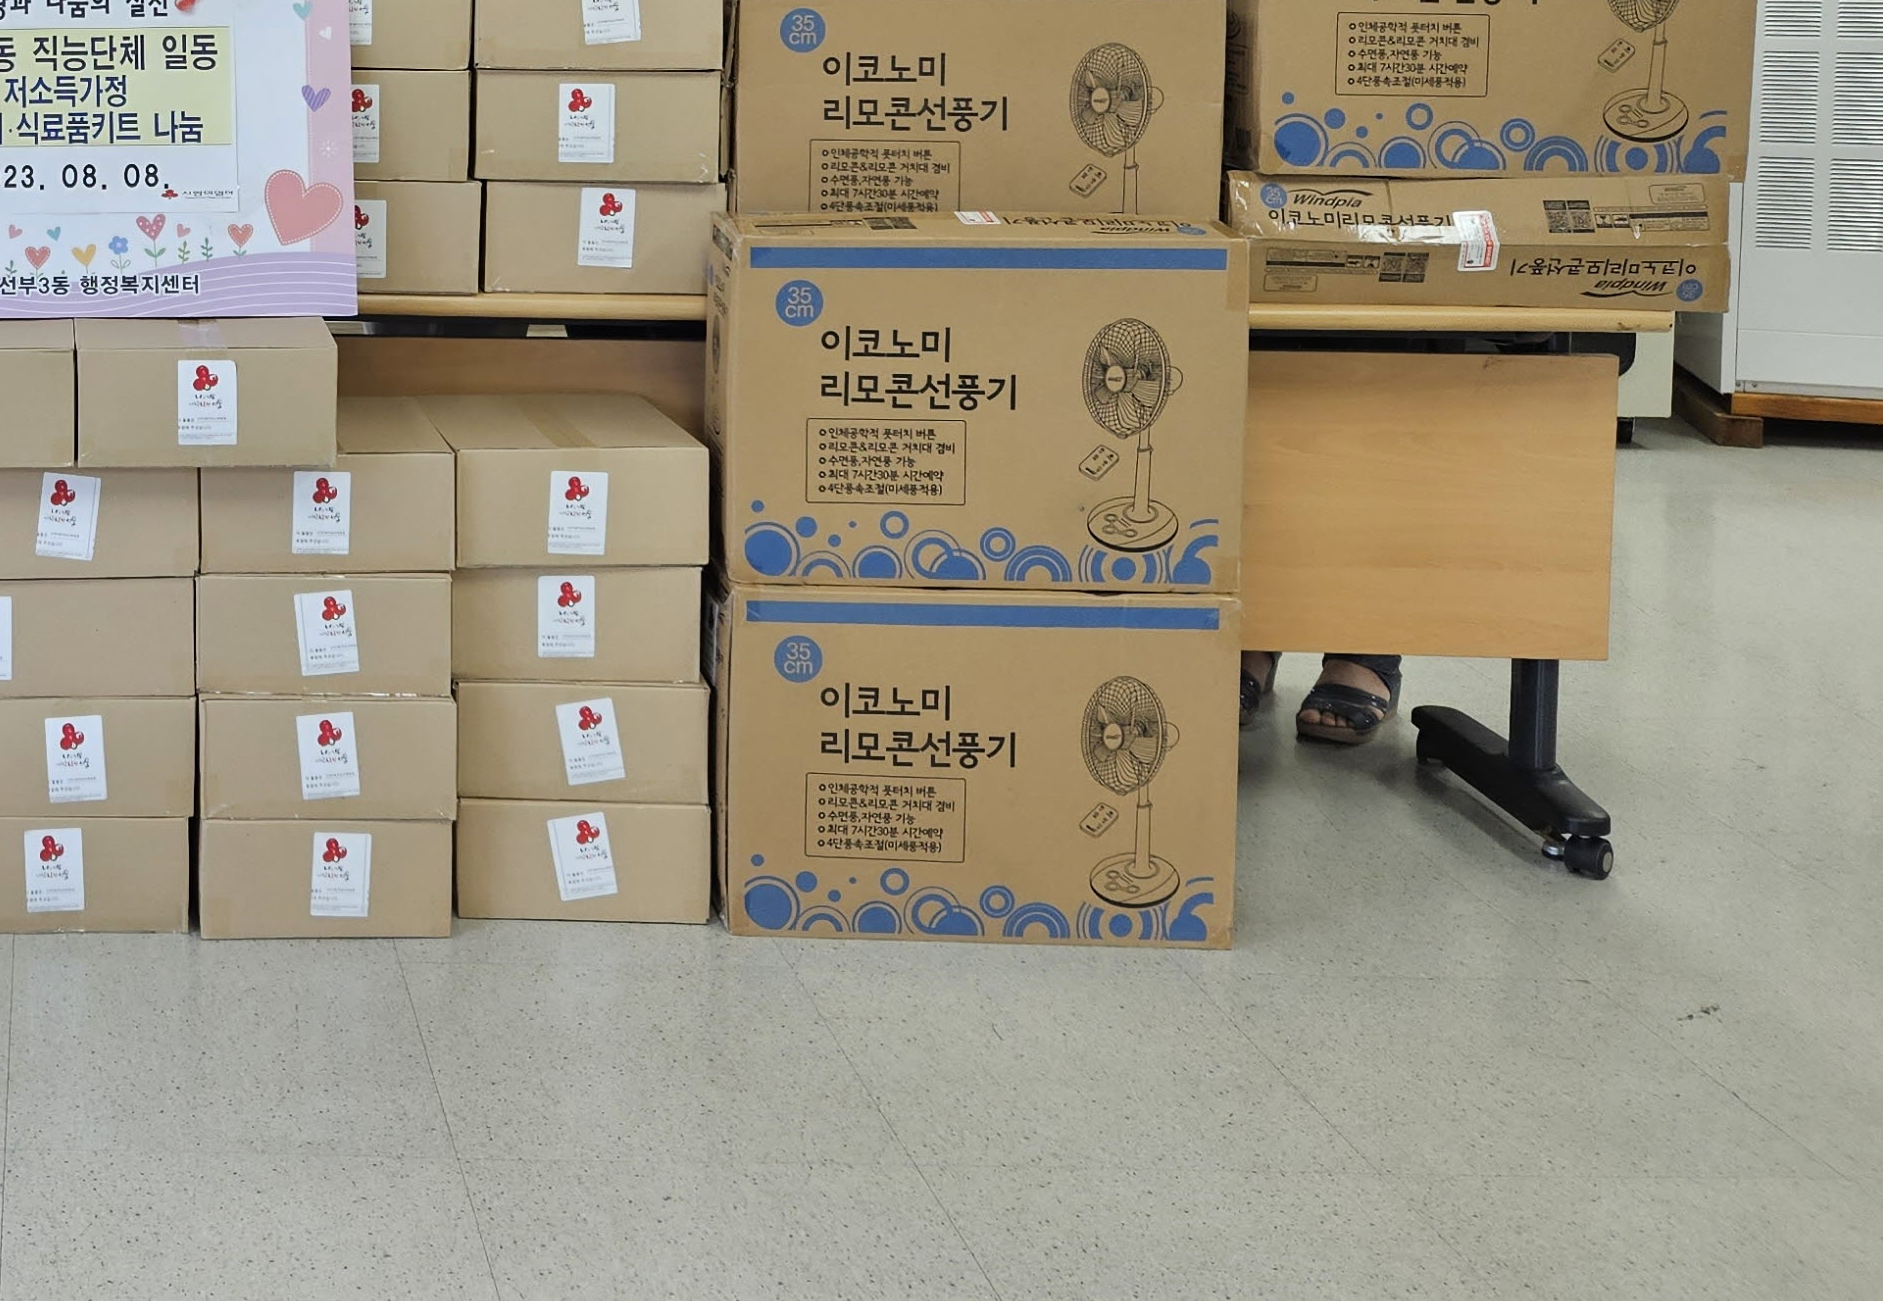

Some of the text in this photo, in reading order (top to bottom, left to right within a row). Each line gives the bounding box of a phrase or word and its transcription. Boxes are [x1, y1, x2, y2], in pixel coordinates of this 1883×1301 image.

[792, 16, 814, 31] 35
[789, 31, 816, 44] cm
[1357, 35, 1425, 47] 리모콘&리모콘
[1428, 36, 1457, 47] 거치대
[33, 34, 146, 72] 직능단체
[162, 34, 218, 71] 일동
[1422, 50, 1442, 61] 기능
[823, 53, 945, 85] 이코노미
[1380, 63, 1424, 74] 7시간30분
[4, 74, 127, 108] 저소득가정
[823, 96, 1007, 131] 리모콘선풍기
[154, 110, 203, 144] 나눔
[830, 162, 897, 173] 리모콘&리모콘
[900, 162, 929, 173] 거치대
[62, 164, 107, 190] 08.
[123, 163, 170, 189] 08.
[894, 176, 914, 187] 기능
[853, 189, 897, 200] 7시간30분
[1293, 194, 1362, 208] Windpia
[1510, 257, 1697, 277] 이코노미리모콘선풍기
[80, 274, 200, 295] 행정복지센터
[1594, 279, 1668, 292] Windpia
[787, 287, 811, 304] 35
[784, 303, 814, 318] cm
[821, 325, 951, 363] 이코노미
[821, 371, 1017, 411] 리모콘선풍기
[828, 441, 899, 454] 리모콘&리모콘
[902, 442, 932, 454] 거치대
[896, 456, 916, 468] 기능
[852, 470, 898, 481] 7시간30분
[787, 644, 811, 661] 35
[783, 660, 813, 674] cm
[820, 683, 949, 719] 이코노미
[820, 728, 1015, 768] 리모콘선풍기
[827, 798, 899, 810] 리모콘&리모콘
[902, 799, 932, 811] 거치대
[896, 813, 916, 825] 기능
[852, 827, 898, 838] 7시간30분
